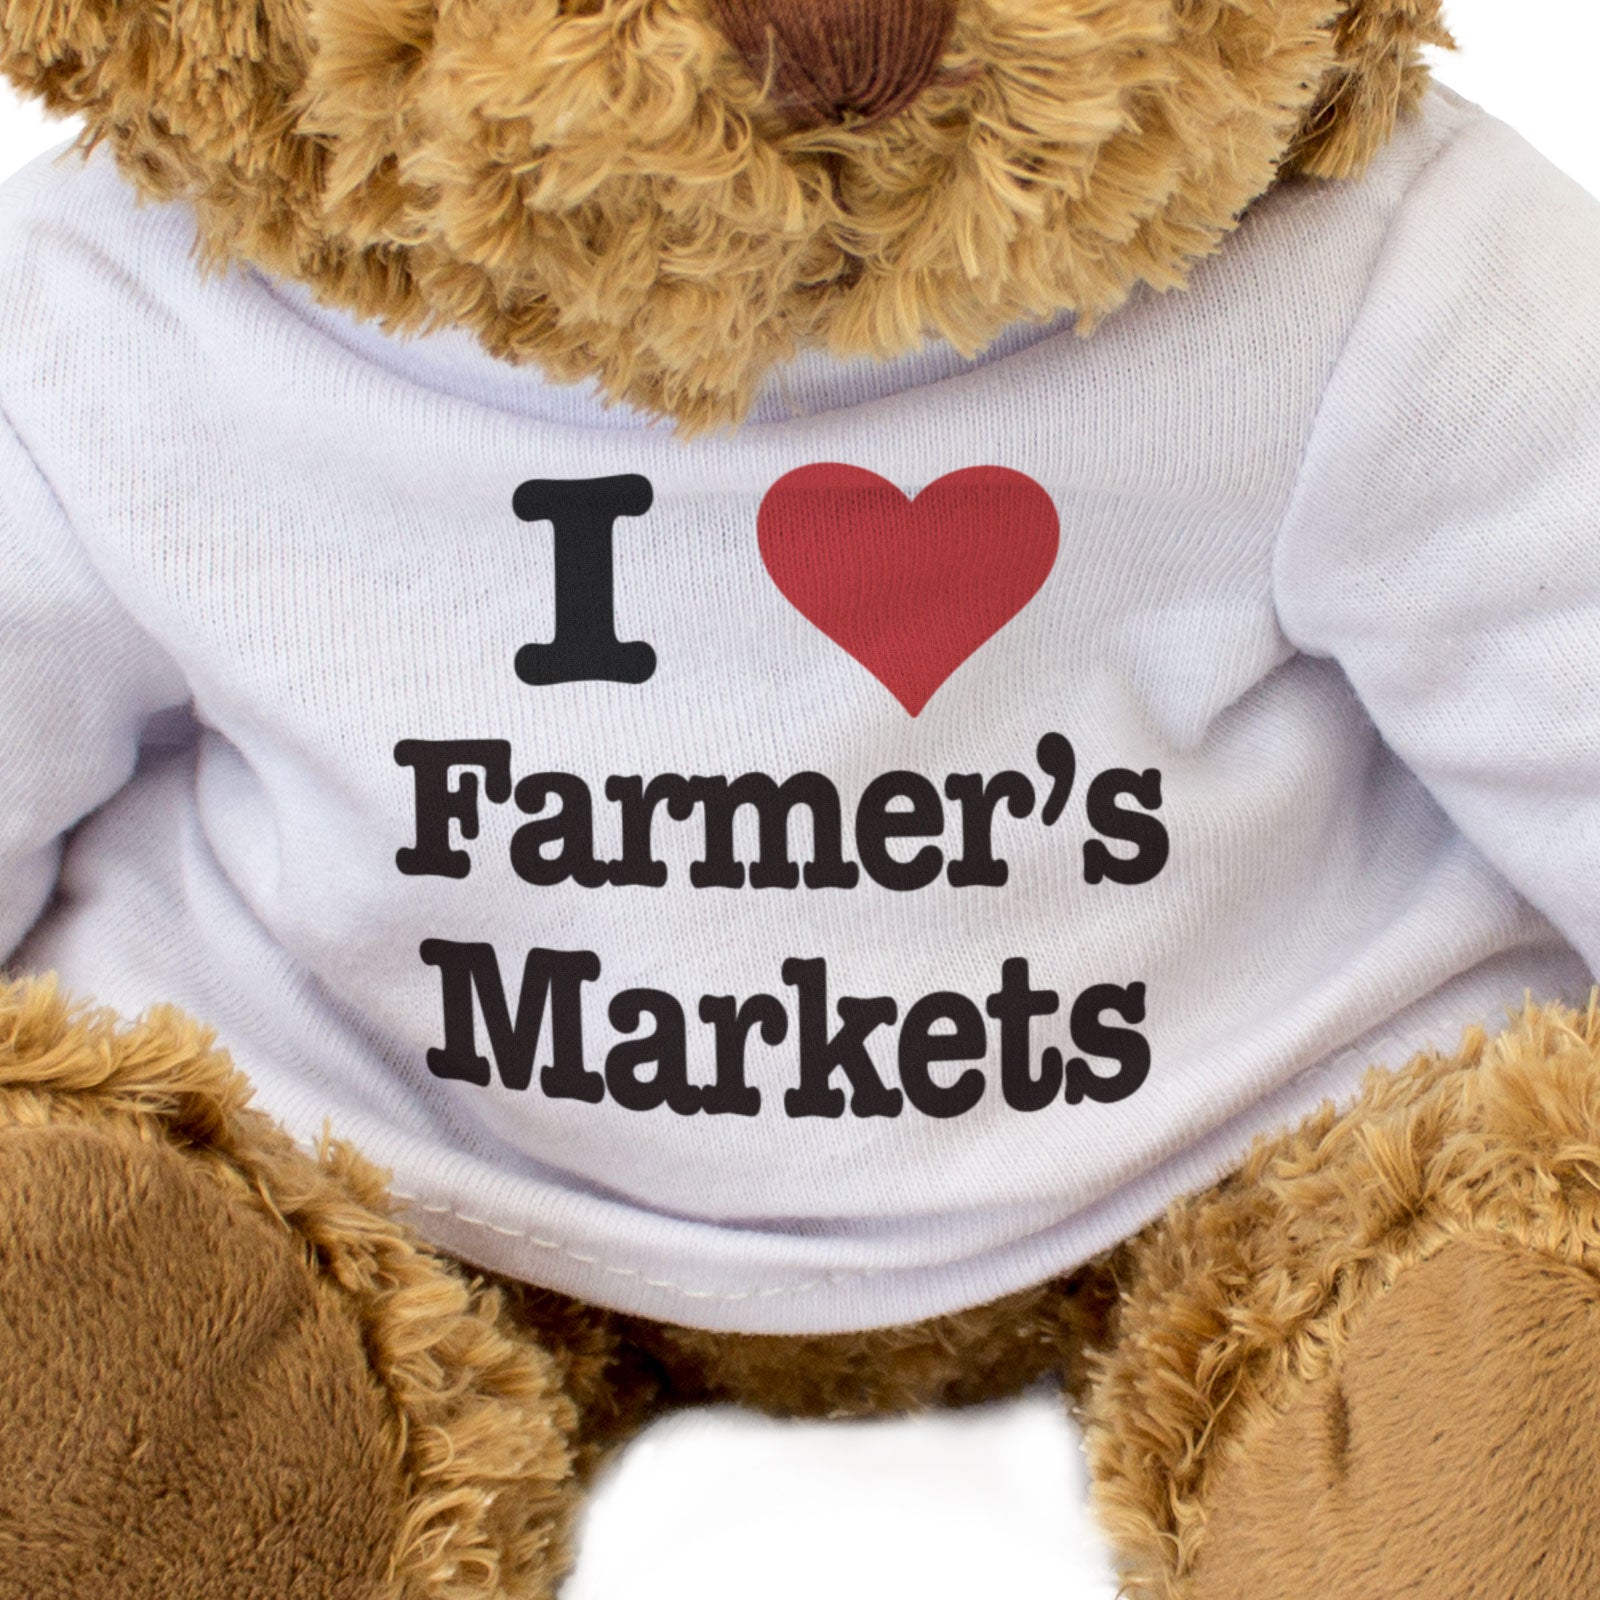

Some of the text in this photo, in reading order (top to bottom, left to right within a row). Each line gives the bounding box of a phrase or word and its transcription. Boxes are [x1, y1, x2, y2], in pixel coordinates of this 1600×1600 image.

[512, 473, 656, 685] I
[393, 731, 1169, 891] Farmer's
[419, 938, 1150, 1118] Markets
